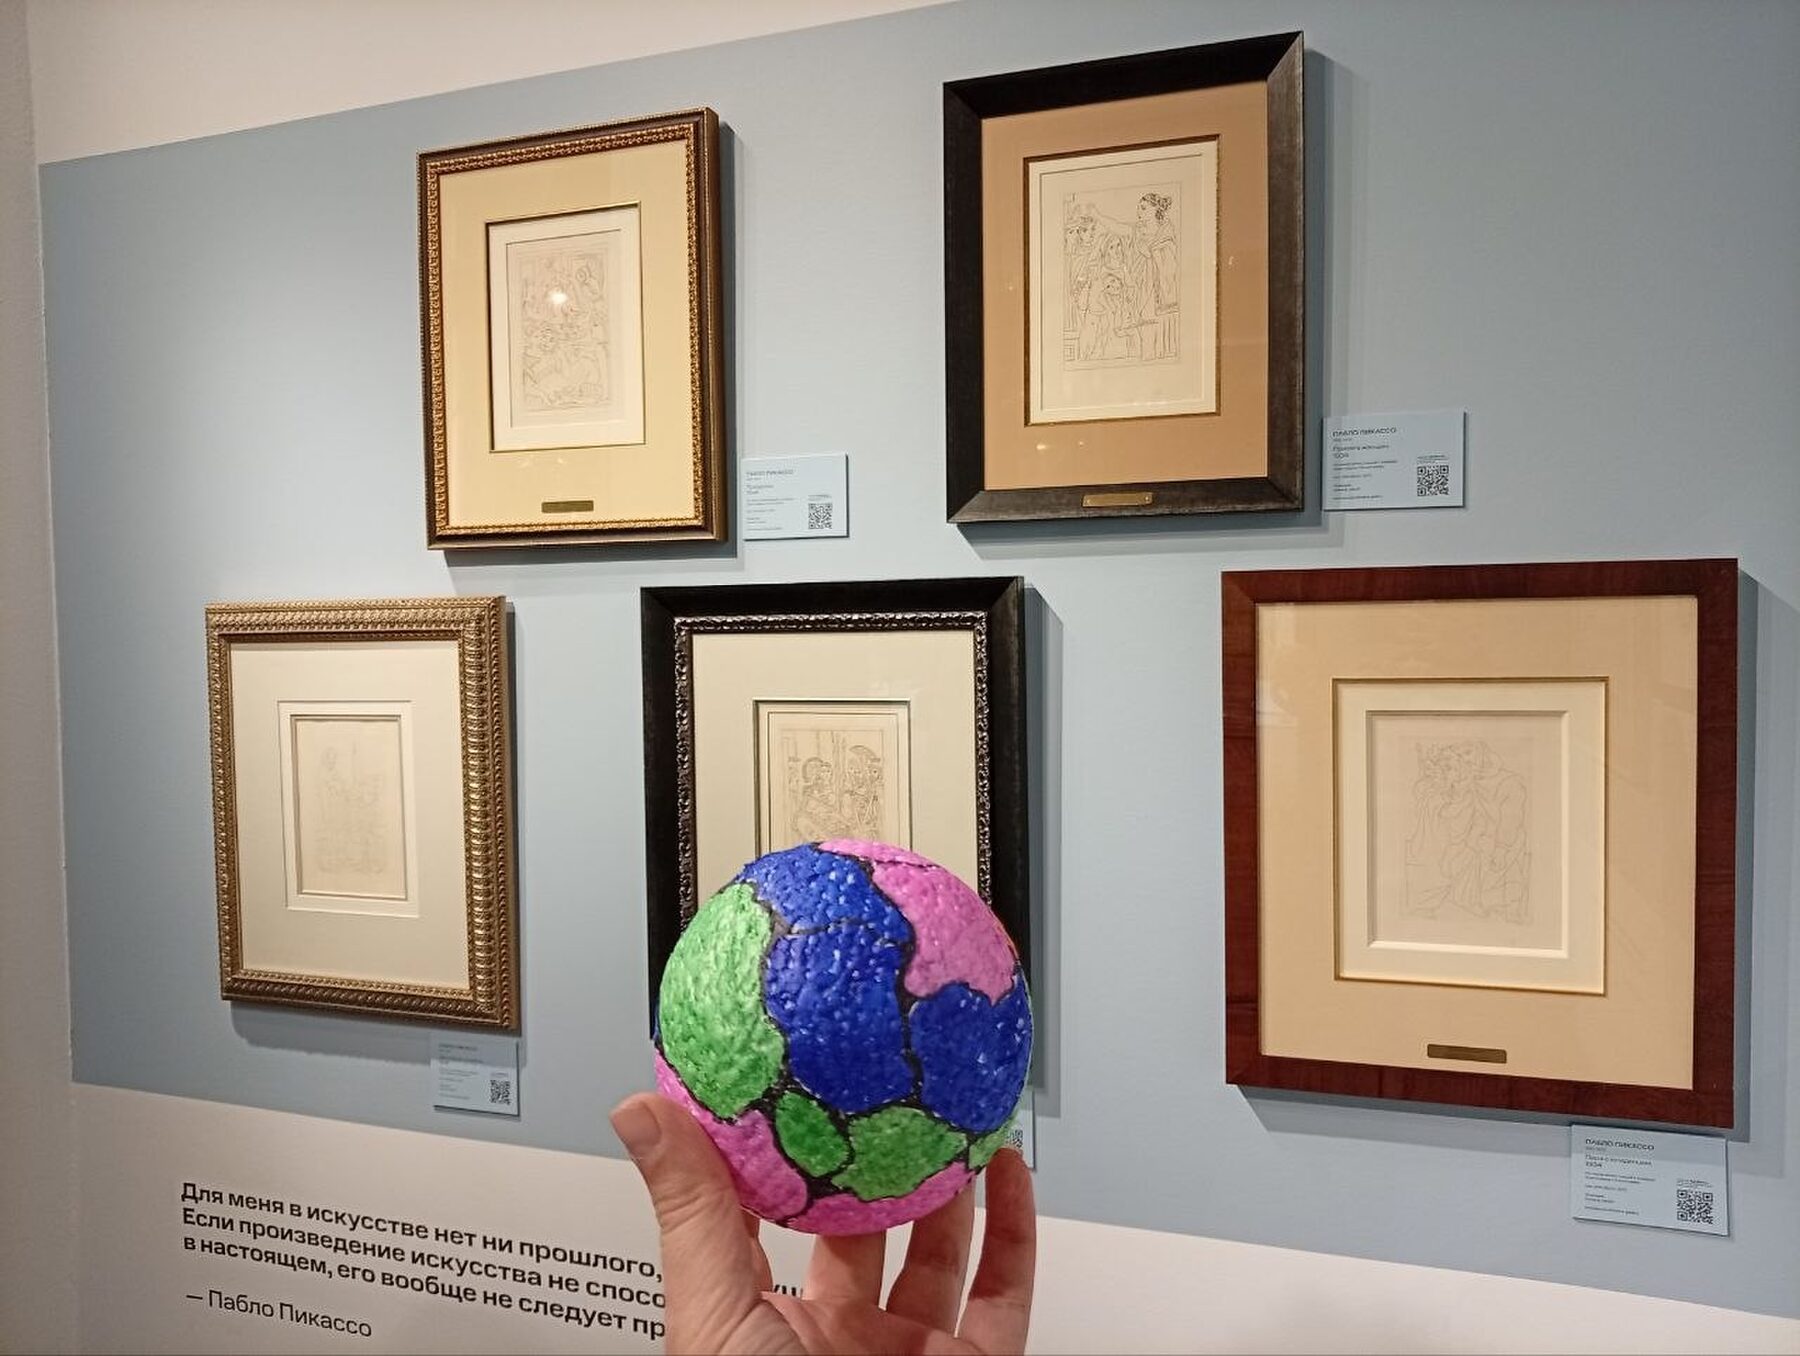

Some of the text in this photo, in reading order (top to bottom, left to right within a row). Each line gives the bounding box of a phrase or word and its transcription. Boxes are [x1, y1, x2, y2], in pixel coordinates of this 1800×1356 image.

[181, 1183, 662, 1283] Для меня в искусстве нет ни прошлого,
[183, 1208, 234, 1232] Если
[240, 1221, 405, 1262] произведение
[412, 1251, 541, 1287] искусства
[549, 1275, 579, 1293] не
[184, 1237, 196, 1251] в
[201, 1239, 332, 1279] настоящем,
[338, 1264, 376, 1284] его
[382, 1272, 477, 1304] вообще
[483, 1291, 512, 1309] не
[519, 1298, 627, 1330] следует
[209, 1290, 275, 1318] Пабло
[280, 1302, 372, 1338] Пикассо
